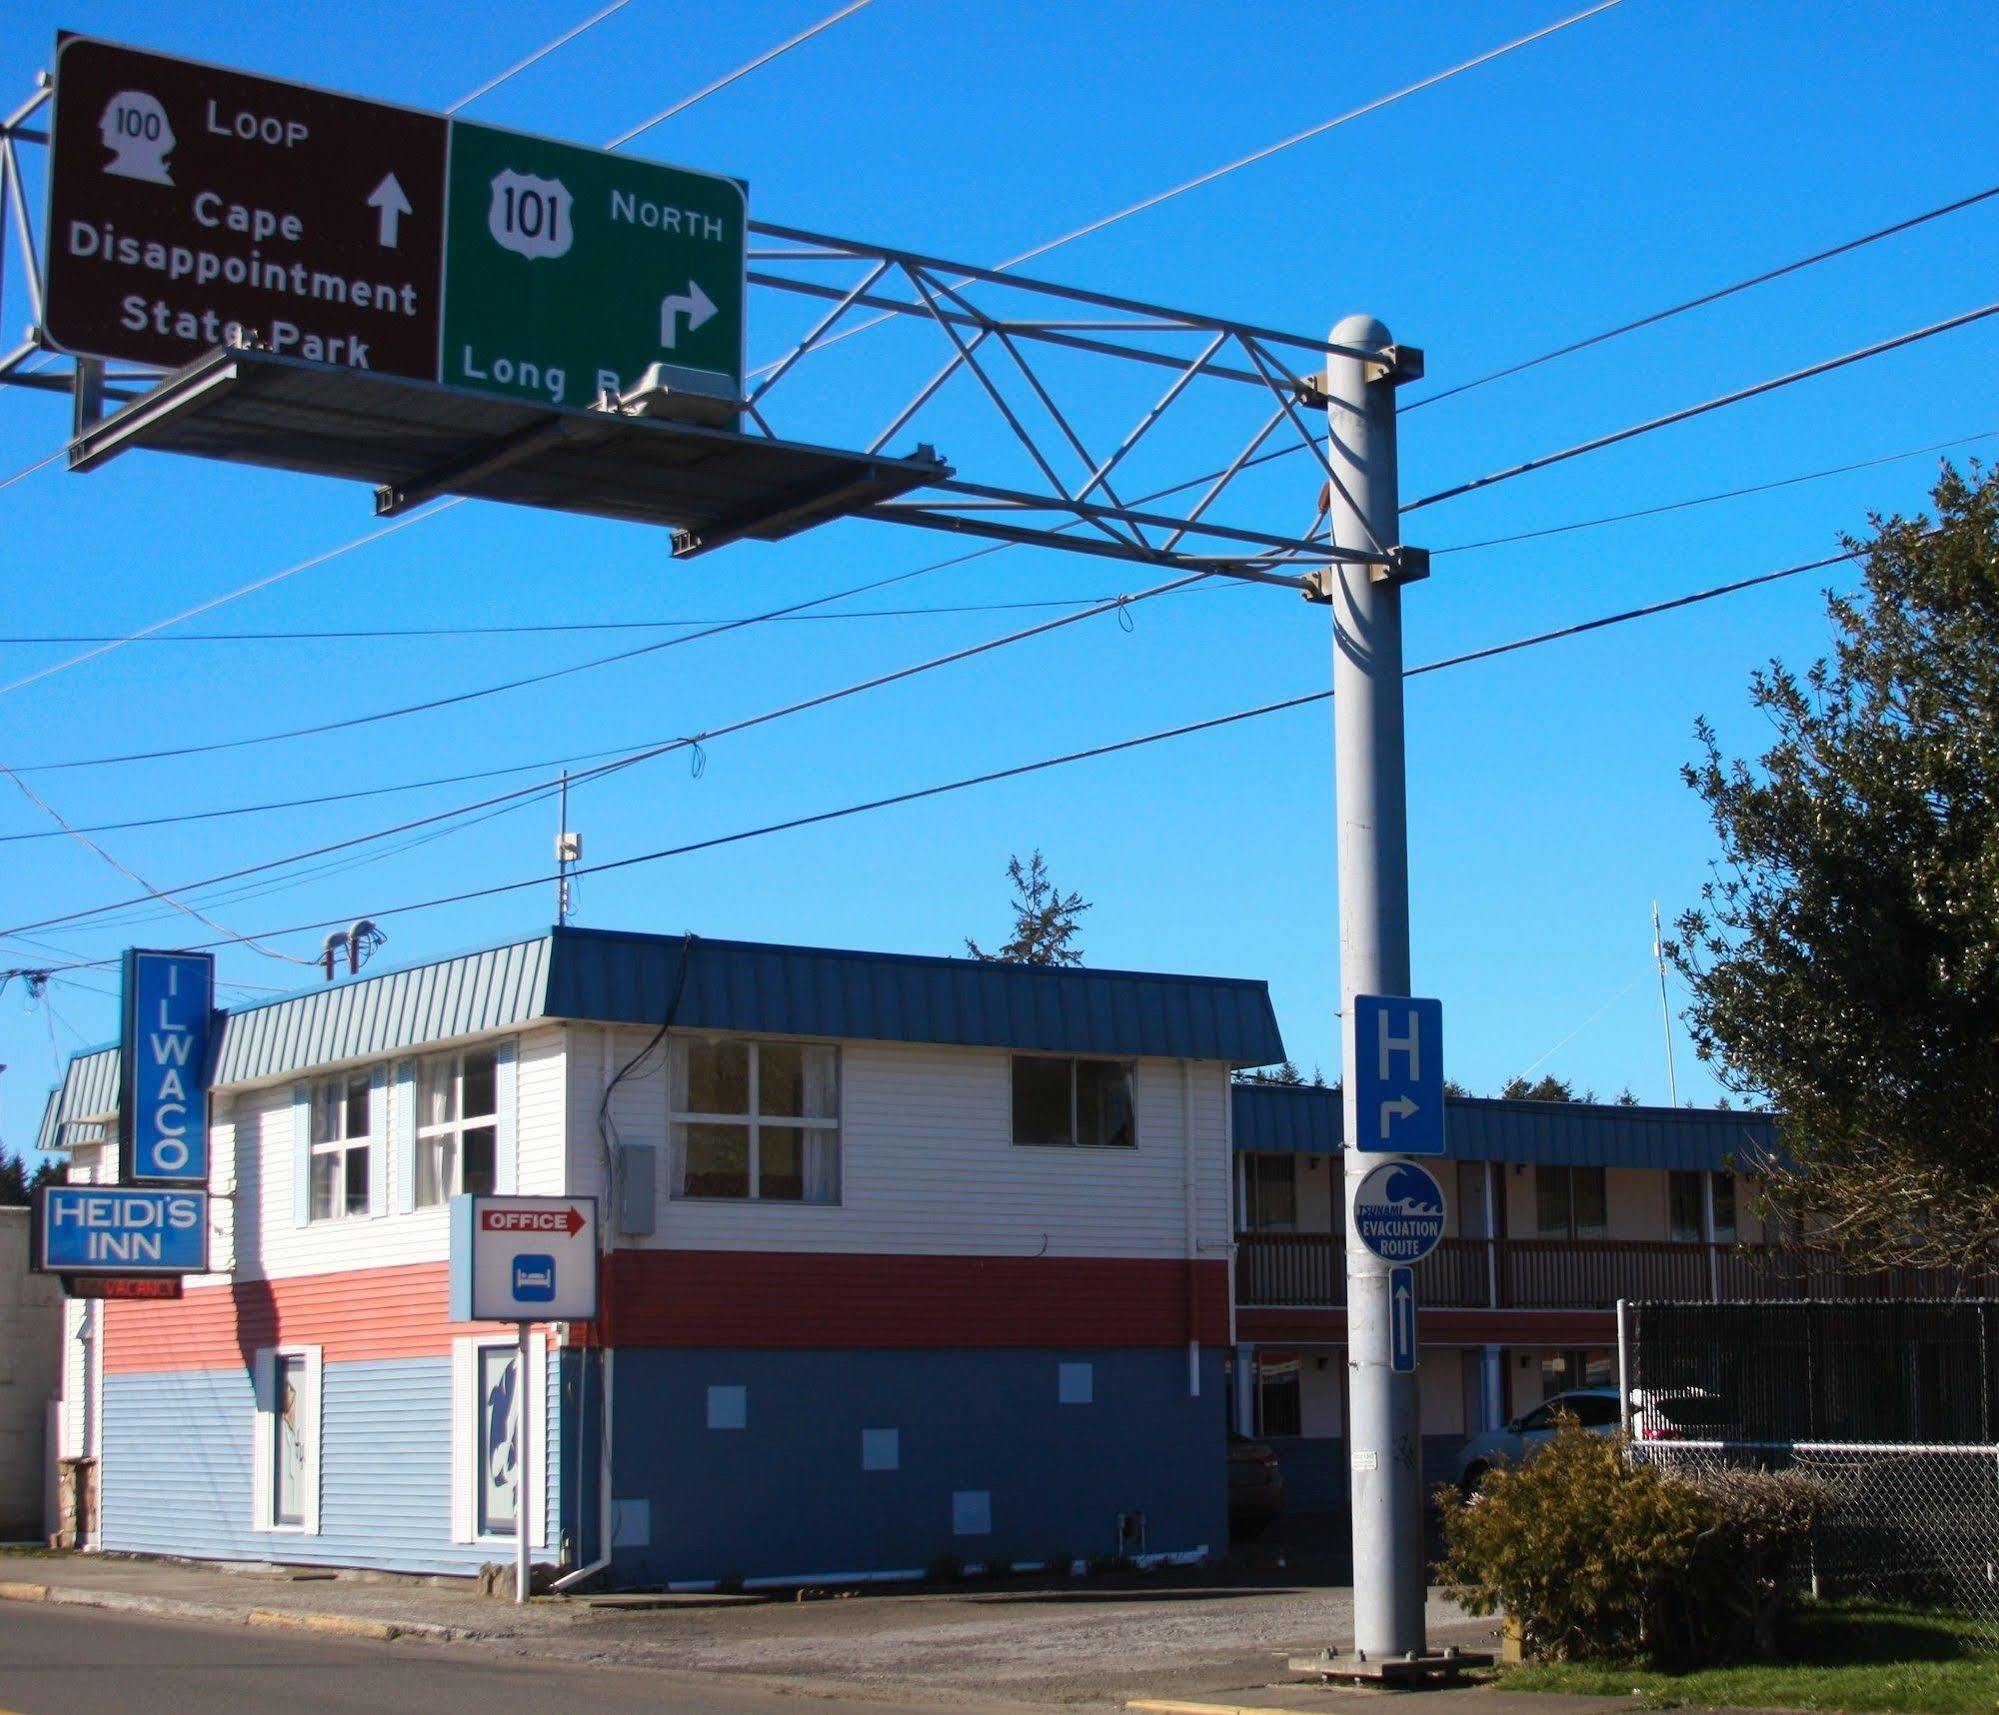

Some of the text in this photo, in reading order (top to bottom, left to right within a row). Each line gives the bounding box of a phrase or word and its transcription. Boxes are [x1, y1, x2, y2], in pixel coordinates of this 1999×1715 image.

[117, 107, 161, 142] 100
[206, 99, 309, 148] LOOP
[194, 192, 304, 242] Cape
[505, 186, 557, 241] 101
[611, 189, 723, 242] NORTH
[69, 220, 418, 317] Disappointment
[272, 320, 370, 369] Park
[463, 344, 567, 404] Long
[150, 964, 193, 1170] ILWACO
[1378, 1008, 1420, 1082] H
[54, 1195, 197, 1230] HEIDI'S
[489, 1212, 569, 1230] OFFICE
[1359, 1204, 1403, 1217] TSUNAMI
[1362, 1220, 1438, 1237] EVACUATION
[88, 1233, 162, 1260] INN
[1380, 1239, 1419, 1255] ROUTE
[105, 1279, 177, 1297] VACANCY
